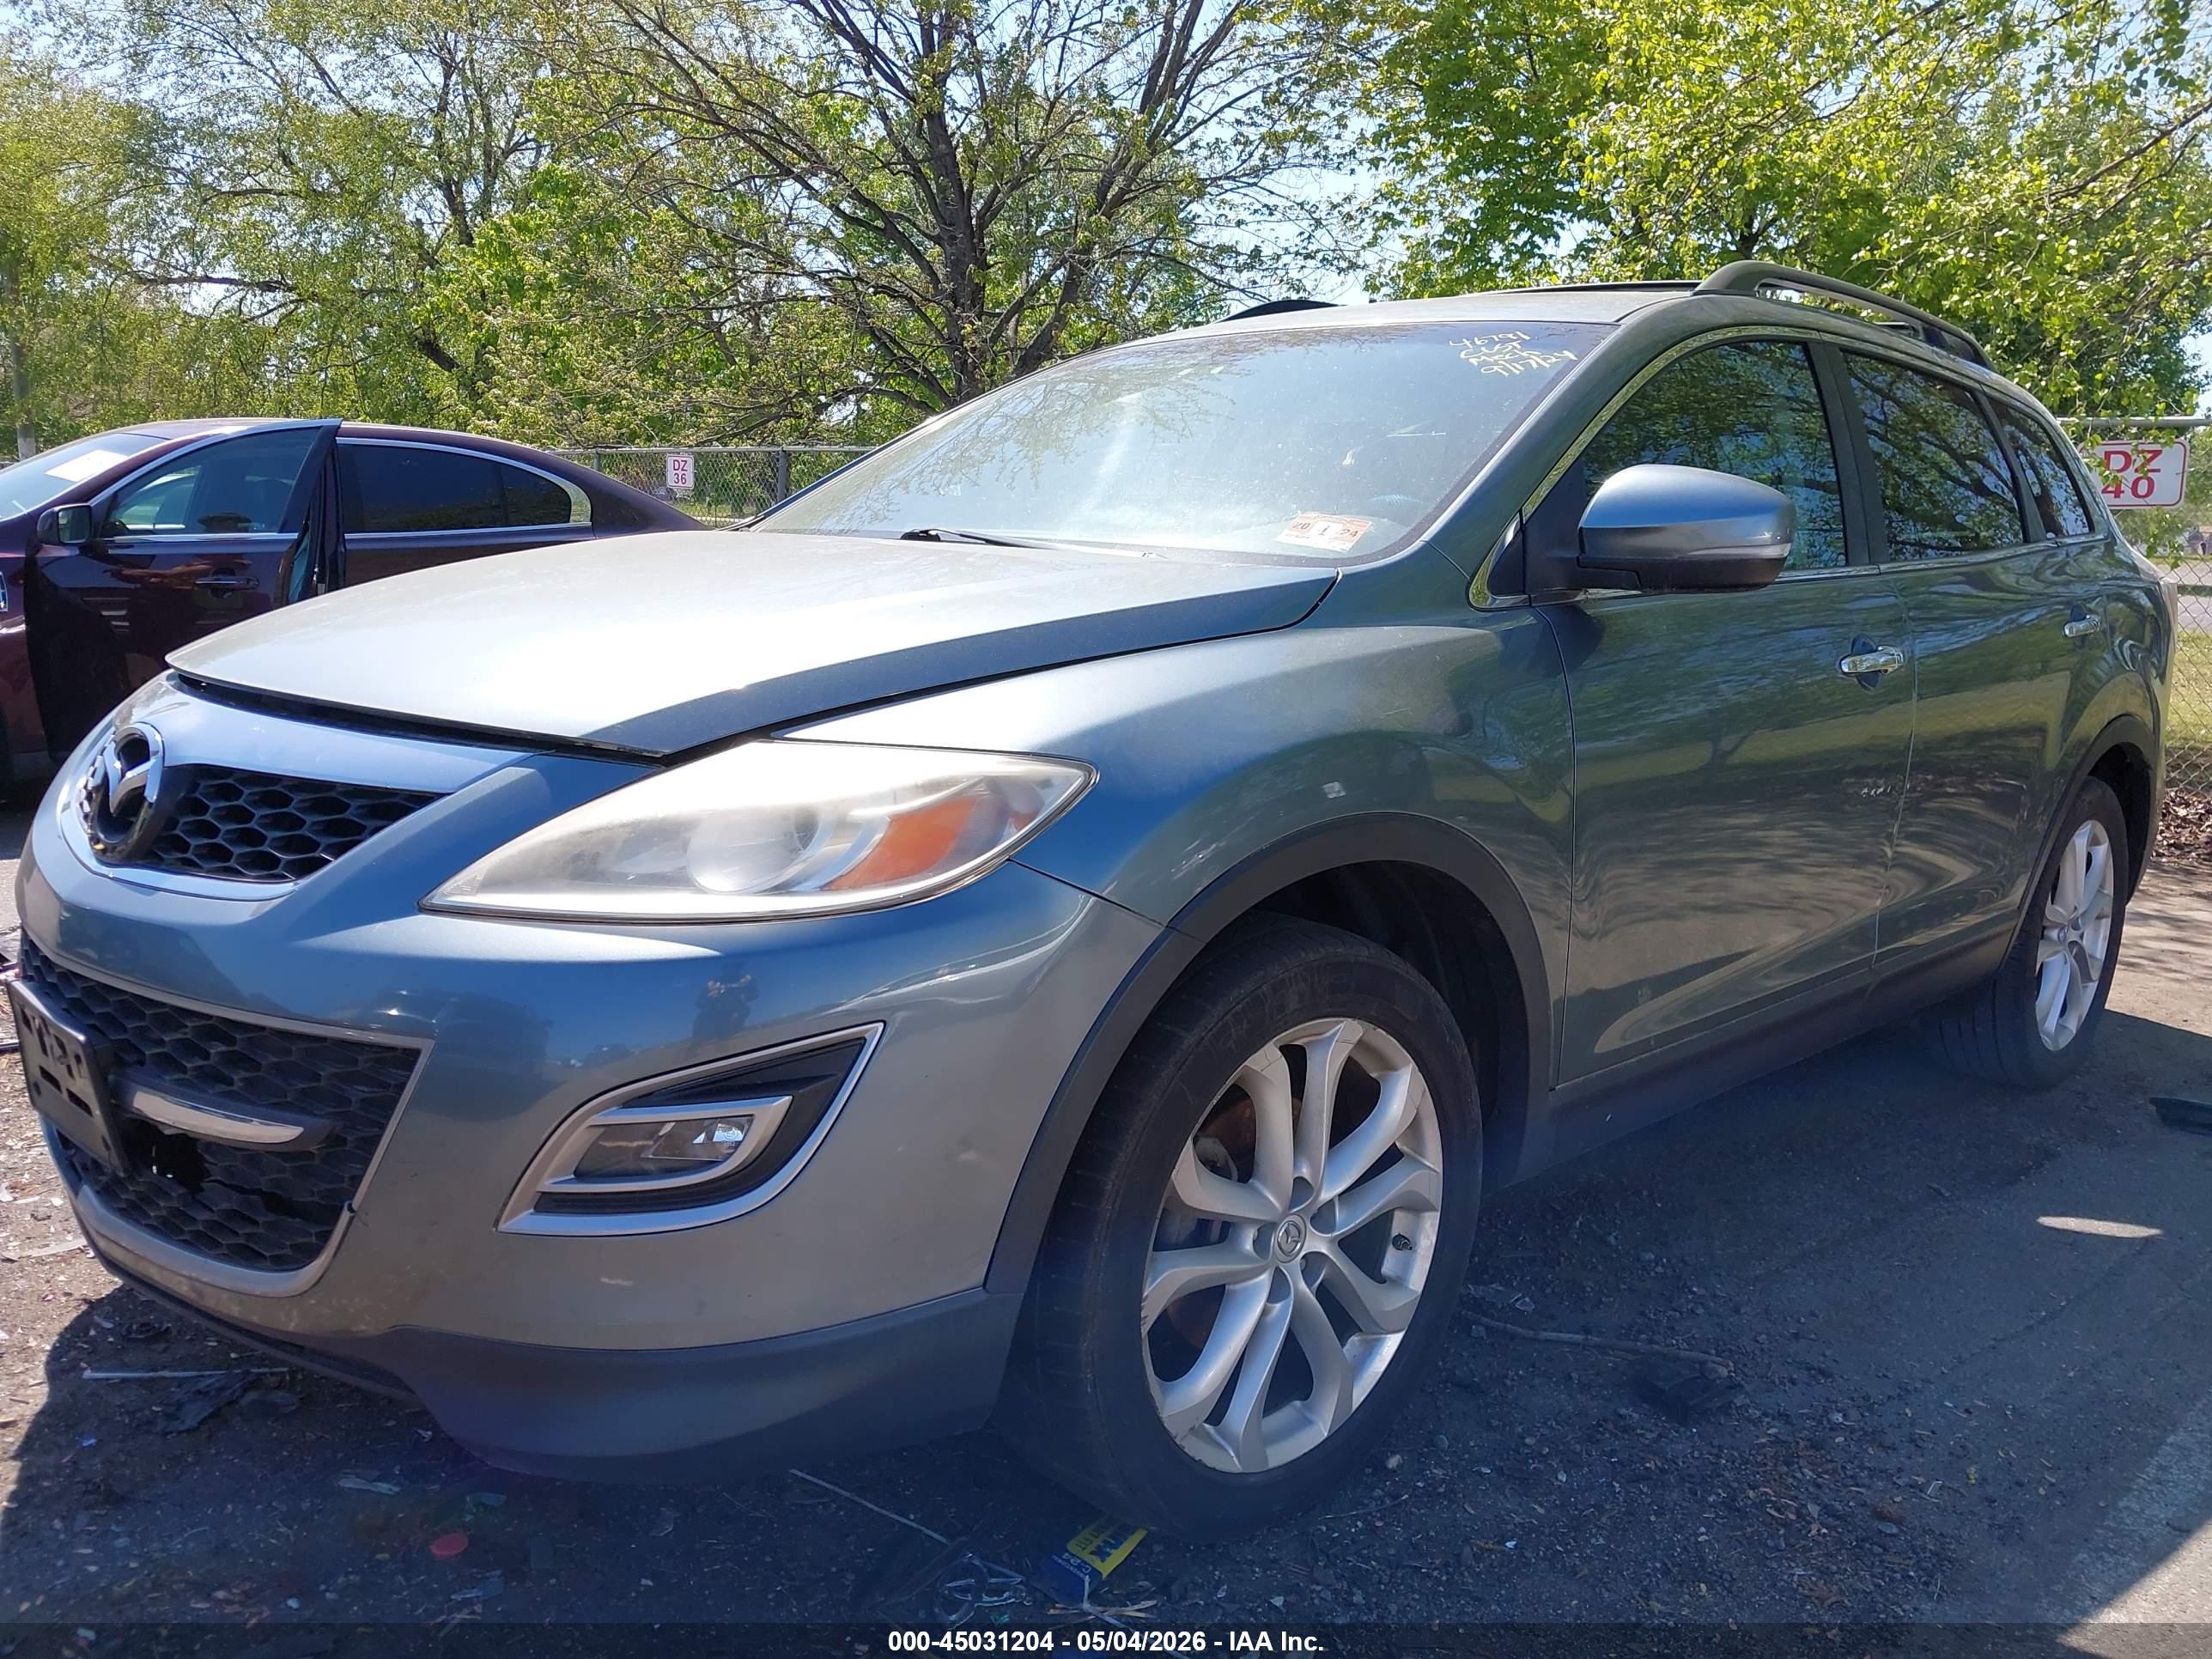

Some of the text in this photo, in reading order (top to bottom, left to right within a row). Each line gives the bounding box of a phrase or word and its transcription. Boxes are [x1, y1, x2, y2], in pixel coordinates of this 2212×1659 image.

[672, 459, 688, 471] DZ
[2104, 449, 2163, 474] DZ
[673, 473, 687, 484] 36
[2101, 476, 2155, 499] 40
[1292, 521, 1311, 531] 20
[1340, 528, 1358, 538] 24
